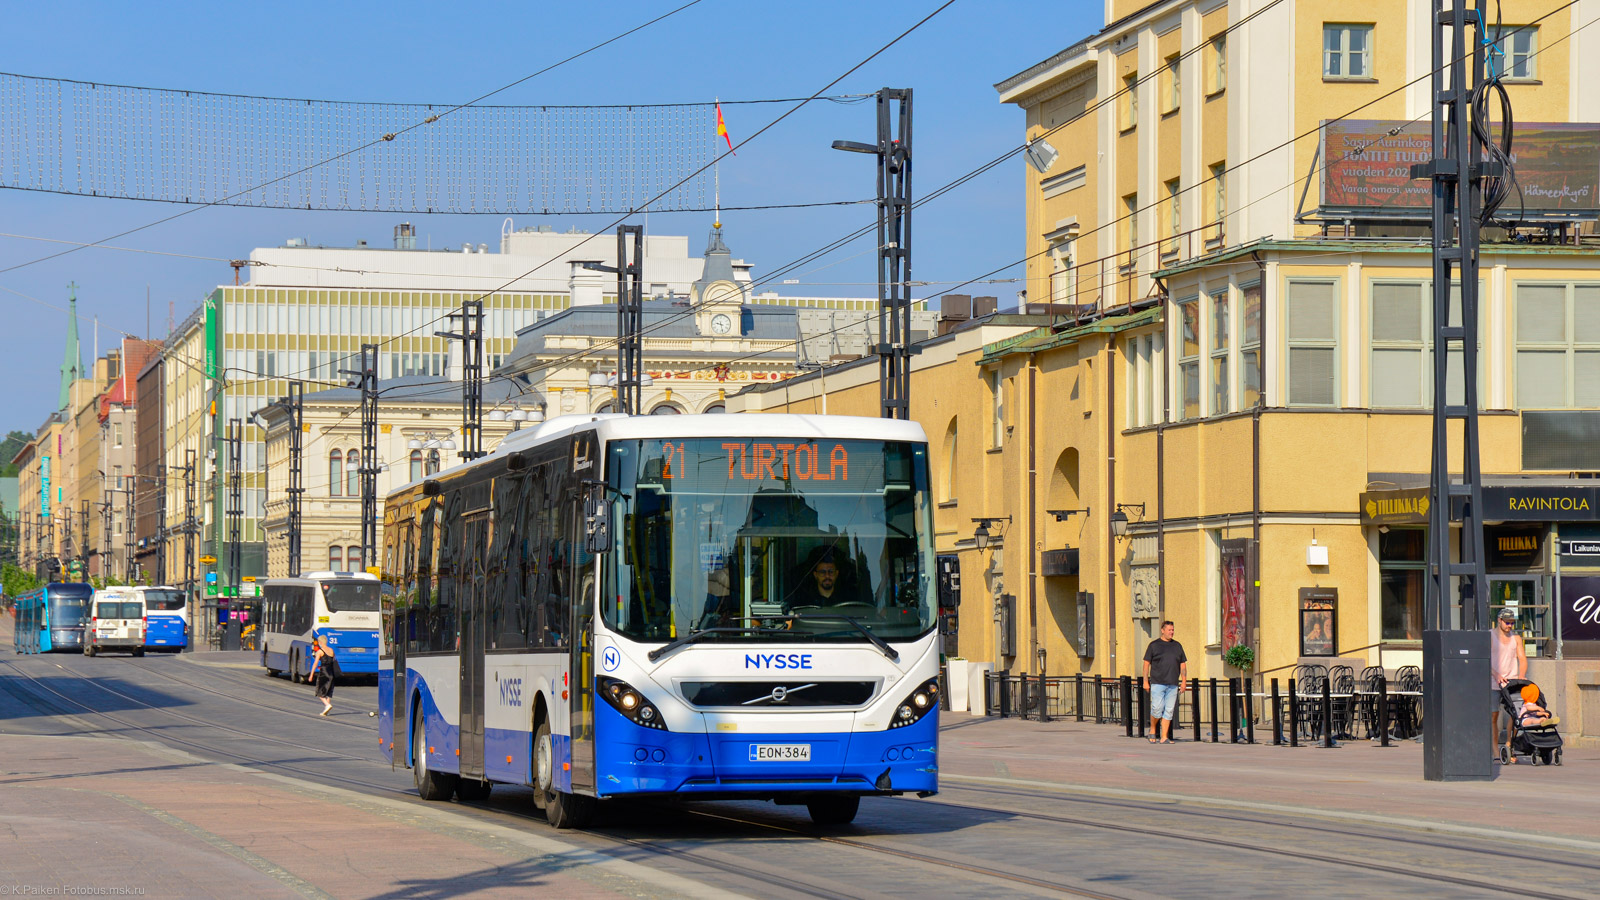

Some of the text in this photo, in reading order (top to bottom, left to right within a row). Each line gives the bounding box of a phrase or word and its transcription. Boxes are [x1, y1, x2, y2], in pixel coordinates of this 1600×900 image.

[1343, 136, 1374, 147] Sasin
[1342, 166, 1384, 177] vuoden
[1341, 184, 1369, 194] Varaa
[662, 442, 848, 480] 21 TURTOLA
[1377, 497, 1419, 515] TILLIKKA
[1509, 497, 1590, 511] RAVINTOLA
[1497, 536, 1538, 551] TILLIKKA
[745, 653, 813, 670] NYSSE
[500, 678, 522, 707] NYSSE
[759, 746, 808, 759] EON-384
